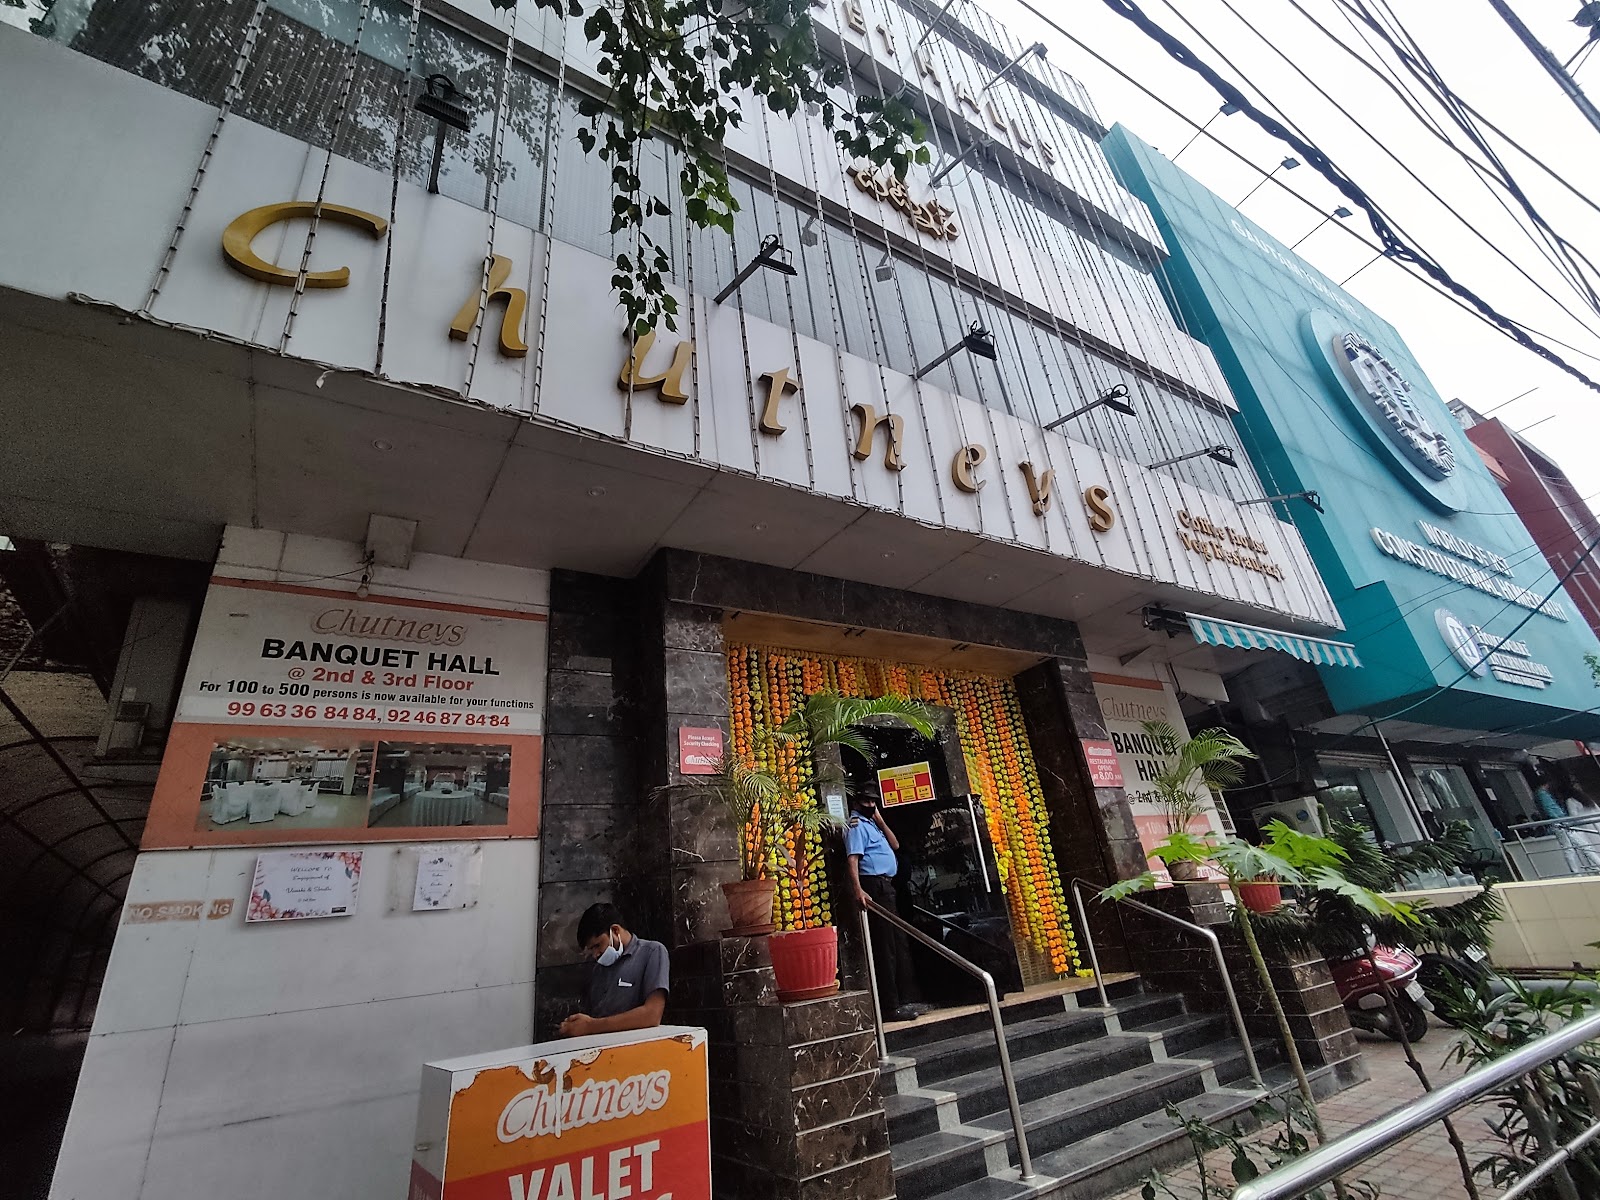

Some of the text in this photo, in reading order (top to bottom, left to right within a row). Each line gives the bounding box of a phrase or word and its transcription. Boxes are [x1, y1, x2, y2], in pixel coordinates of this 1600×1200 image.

[914, 49, 1057, 165] HALLS
[222, 201, 1115, 533] Chutneys
[1177, 510, 1225, 540] Coffe
[1177, 531, 1213, 561] Veg
[1371, 527, 1503, 597] CONSTITUTIONAL
[1476, 545, 1515, 578] FRST
[314, 608, 465, 644] Chutneys
[261, 638, 500, 676] BANQUET HALL
[200, 680, 534, 709] For 100 to 500 persons is now available for your functions
[288, 667, 474, 691] @ 2nd & 3rd Floor
[1101, 697, 1167, 720] Chutneys
[129, 903, 232, 919] NO SMOKNG
[499, 1071, 668, 1140] Chutneys
[508, 1139, 660, 1200] VALET
